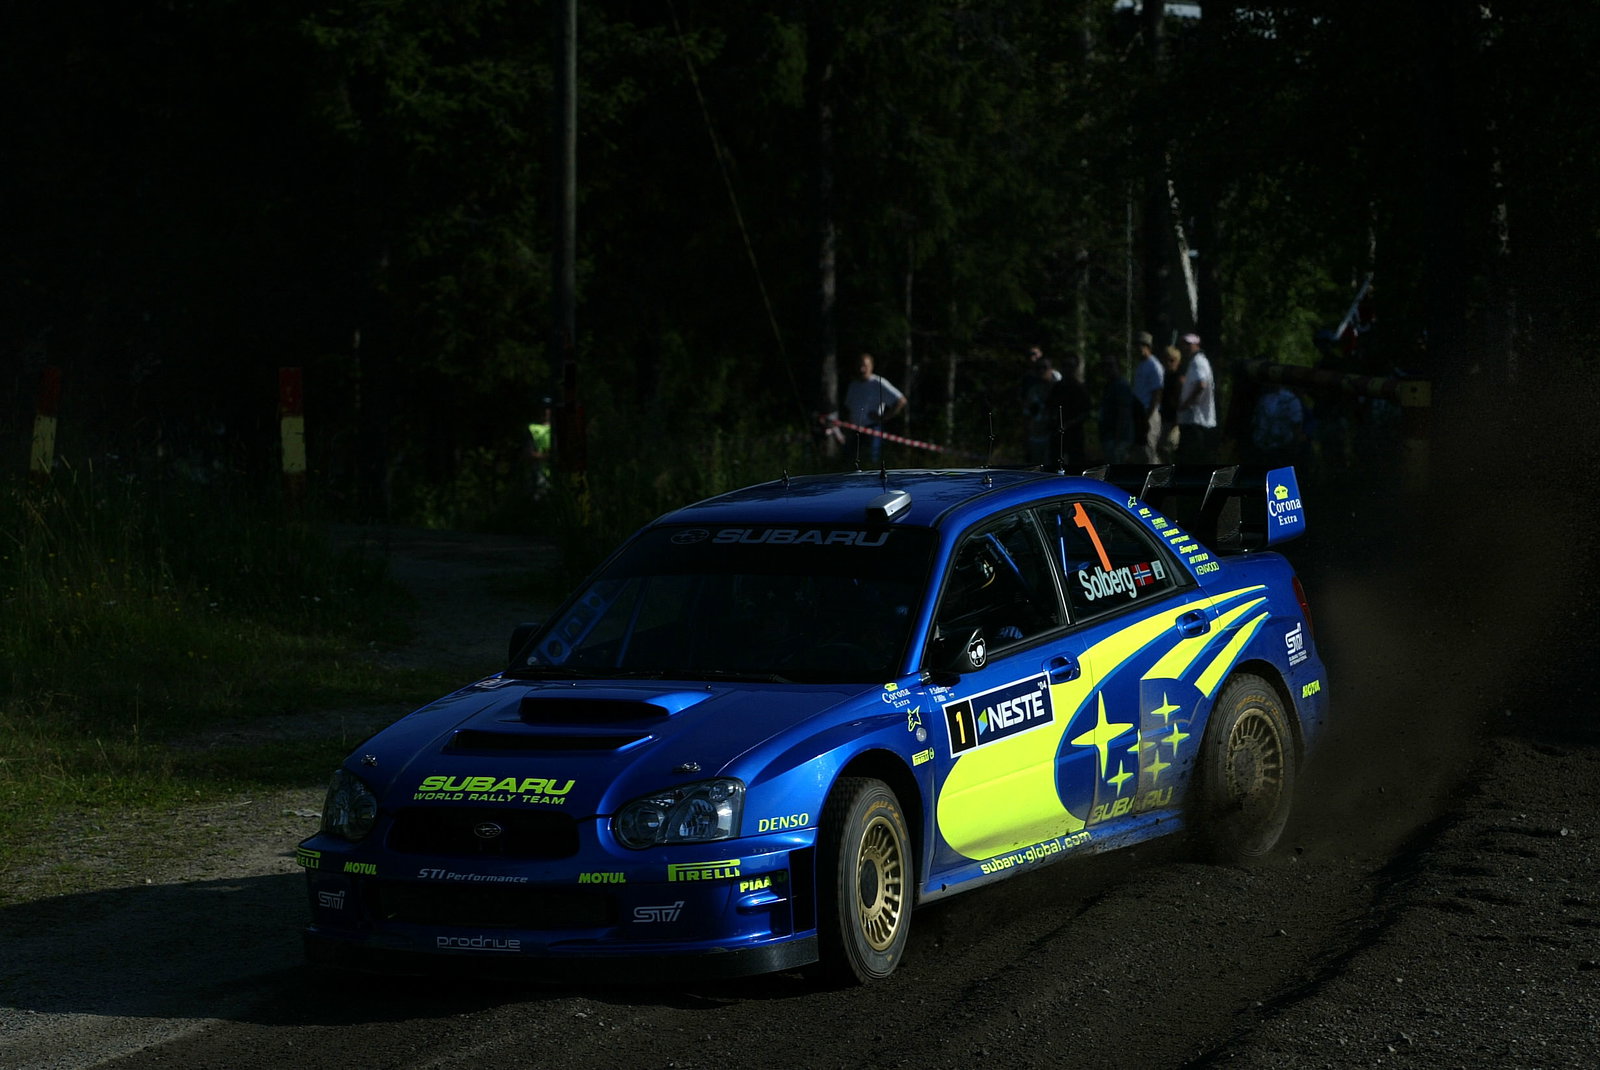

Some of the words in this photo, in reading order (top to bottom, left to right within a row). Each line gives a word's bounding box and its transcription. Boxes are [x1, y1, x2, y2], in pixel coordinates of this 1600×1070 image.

[1268, 498, 1302, 517] Corona
[1278, 514, 1298, 526] Extra
[712, 528, 892, 547] SUBARU
[1072, 502, 1113, 572] 1
[1195, 561, 1220, 576] KENWOOD
[1078, 565, 1138, 602] Solberg
[881, 687, 911, 704] Corona
[893, 698, 911, 709] Extra
[955, 711, 967, 744] 1
[987, 690, 1045, 733] NESTE
[418, 775, 576, 795] SUBARU
[413, 792, 463, 801] WORLD
[468, 793, 517, 803] RALLY
[522, 794, 566, 806] TEAM
[758, 812, 810, 833] DENSO
[343, 861, 377, 876] MOTUL
[417, 868, 446, 880] STI
[447, 871, 529, 884] Performance
[667, 858, 741, 882] PIRELLI
[578, 872, 627, 884] MOTUL
[739, 876, 773, 893] PIAA
[437, 934, 521, 952] prodrive
